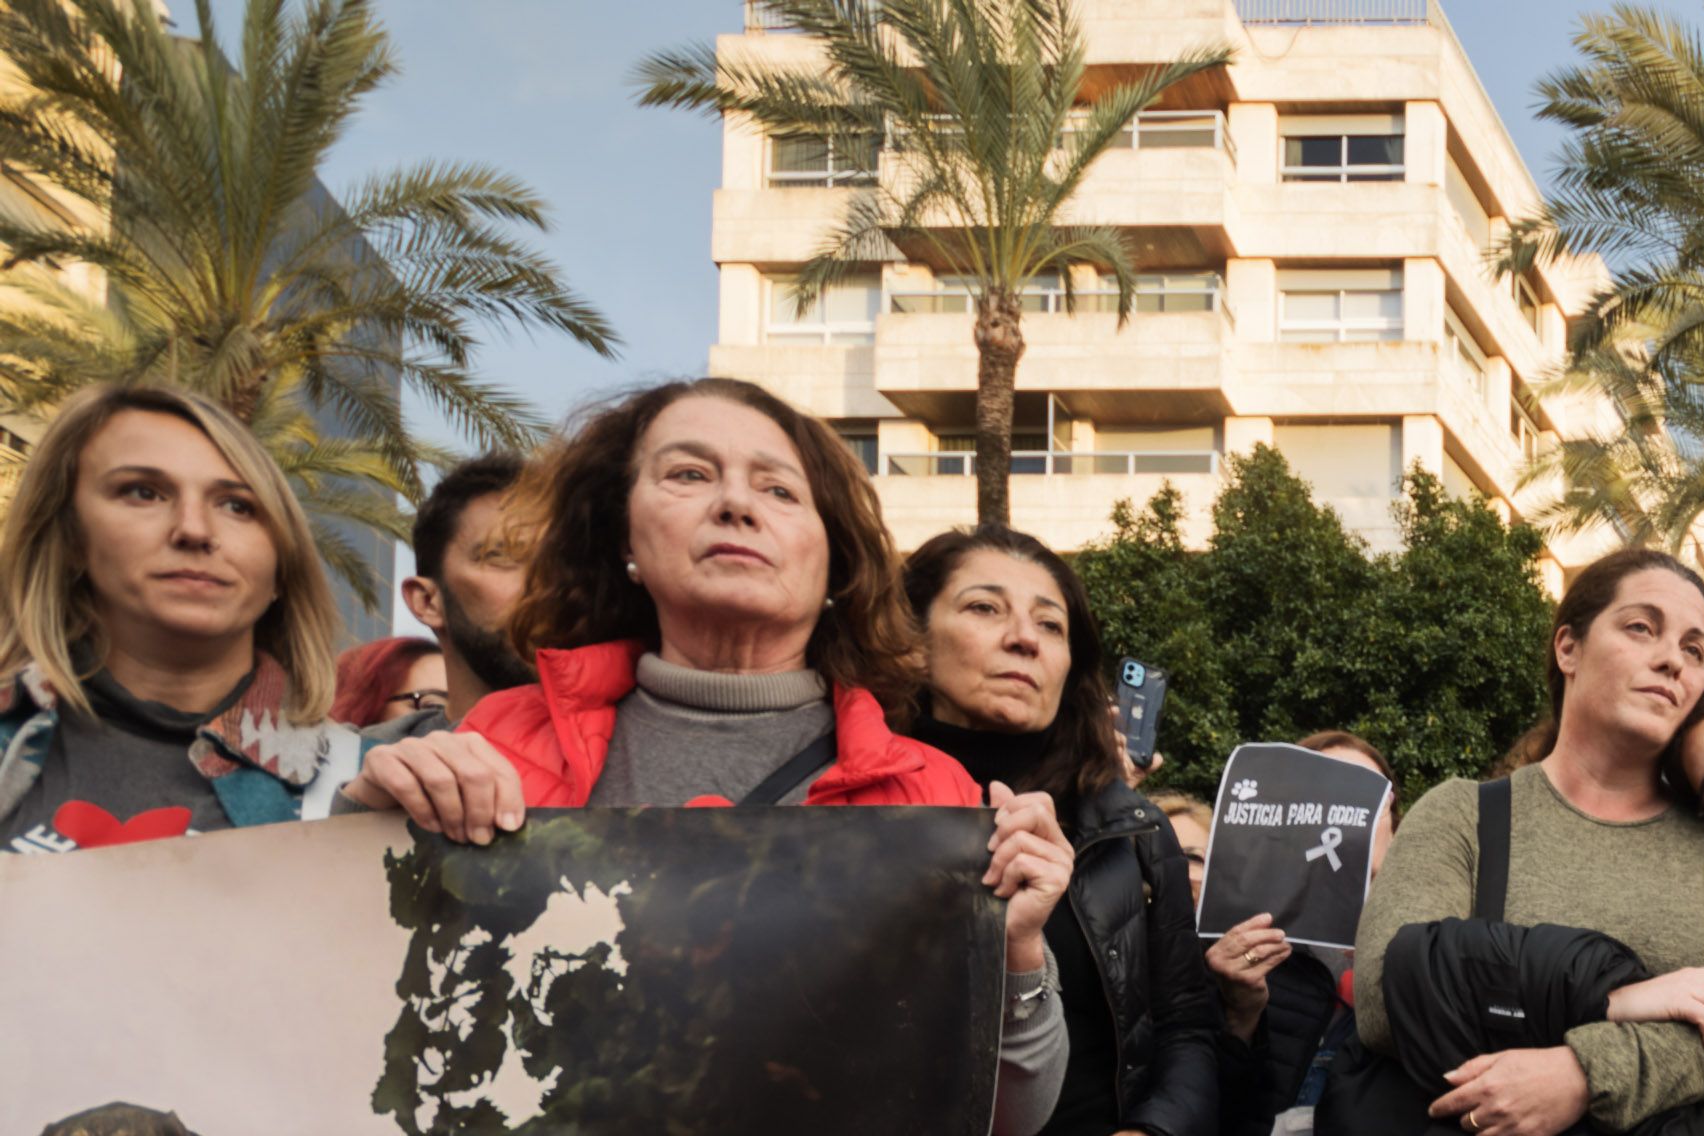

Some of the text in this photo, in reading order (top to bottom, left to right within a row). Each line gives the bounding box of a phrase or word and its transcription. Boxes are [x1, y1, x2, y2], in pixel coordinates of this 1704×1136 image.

[1223, 802, 1370, 828] JUSTICIA PARA ODDIE
